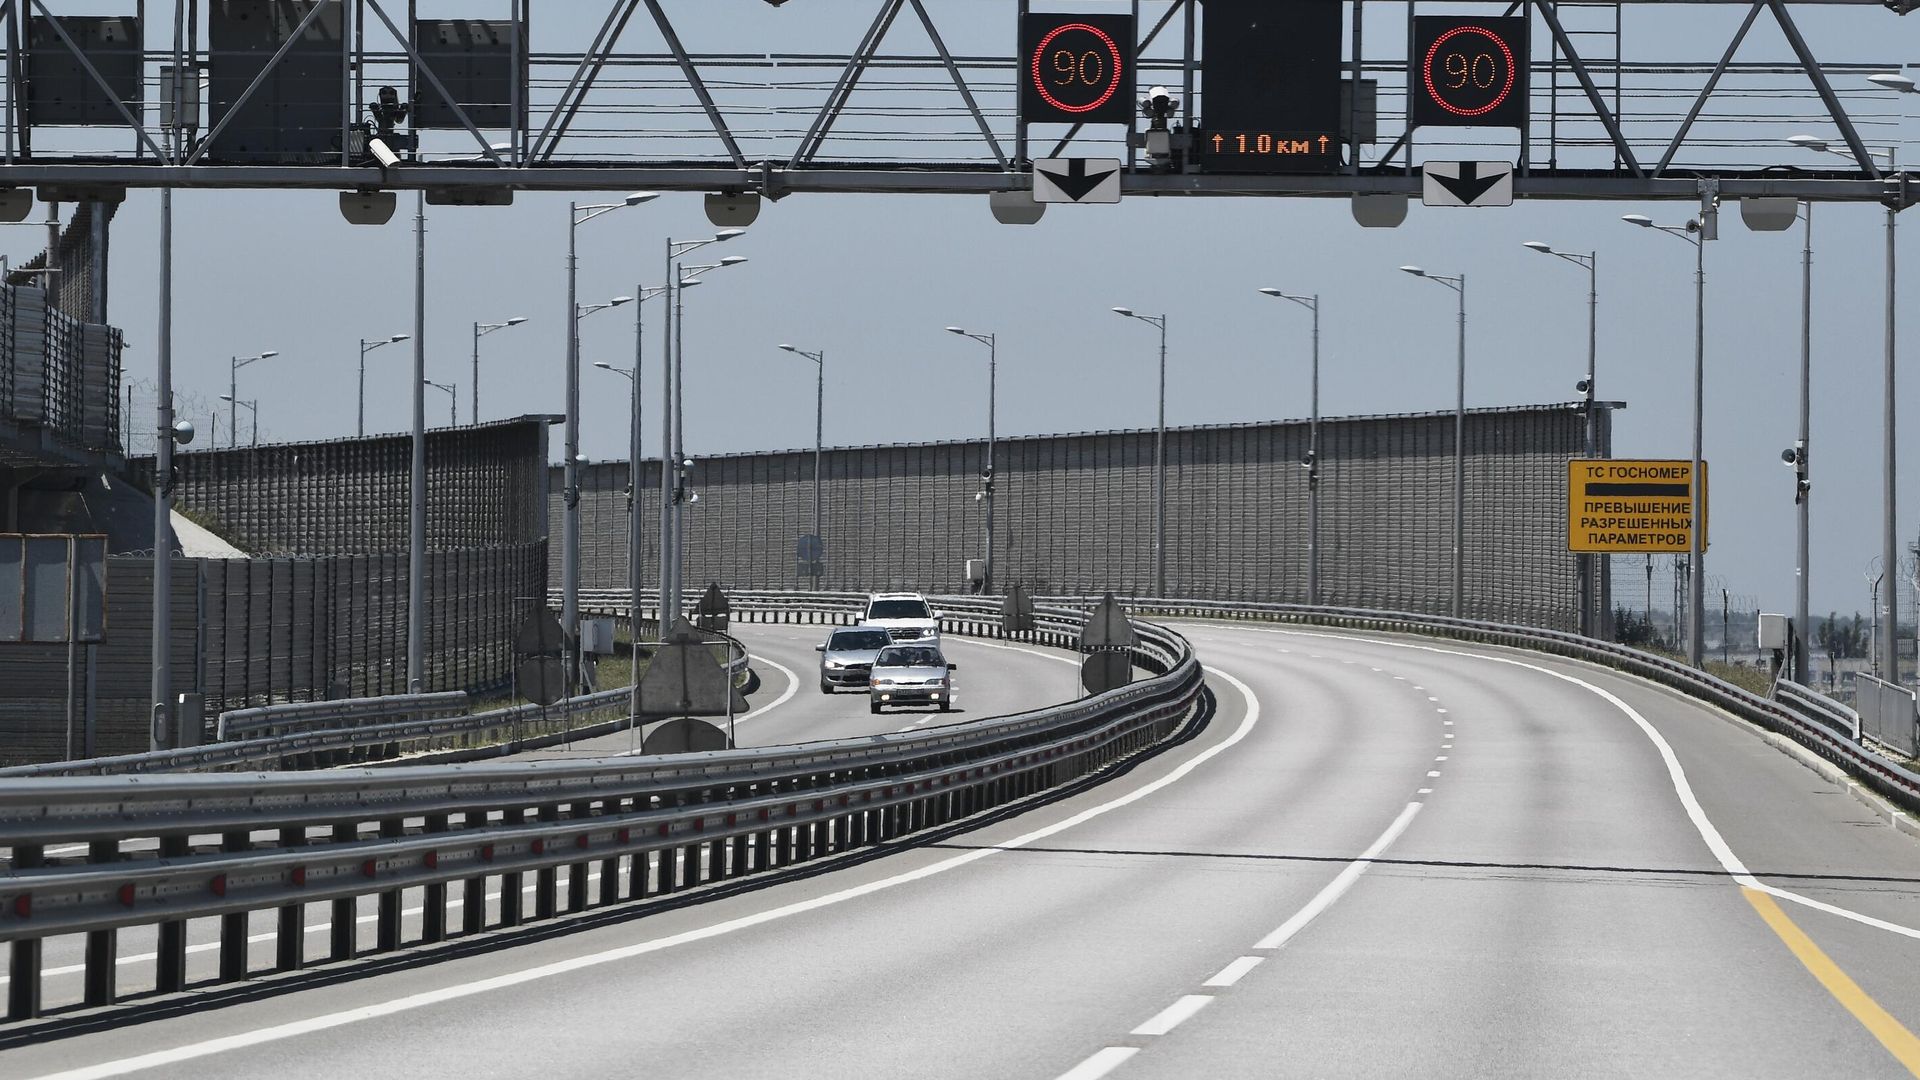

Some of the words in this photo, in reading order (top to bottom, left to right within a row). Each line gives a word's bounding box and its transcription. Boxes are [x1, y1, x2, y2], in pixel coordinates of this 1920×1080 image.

[1052, 49, 1104, 86] 90
[1445, 53, 1497, 90] 90
[1235, 134, 1271, 153] 1.0
[1277, 140, 1310, 154] км
[1586, 466, 1605, 479] ТС
[1609, 466, 1690, 479] ГОСНОМЕР
[1584, 502, 1691, 514] ПРЕВЫШЕНИЕ
[1580, 517, 1692, 530] РАЗРЕШЕННЫХ
[1588, 533, 1687, 546] ПАРАМЕТРОВ
